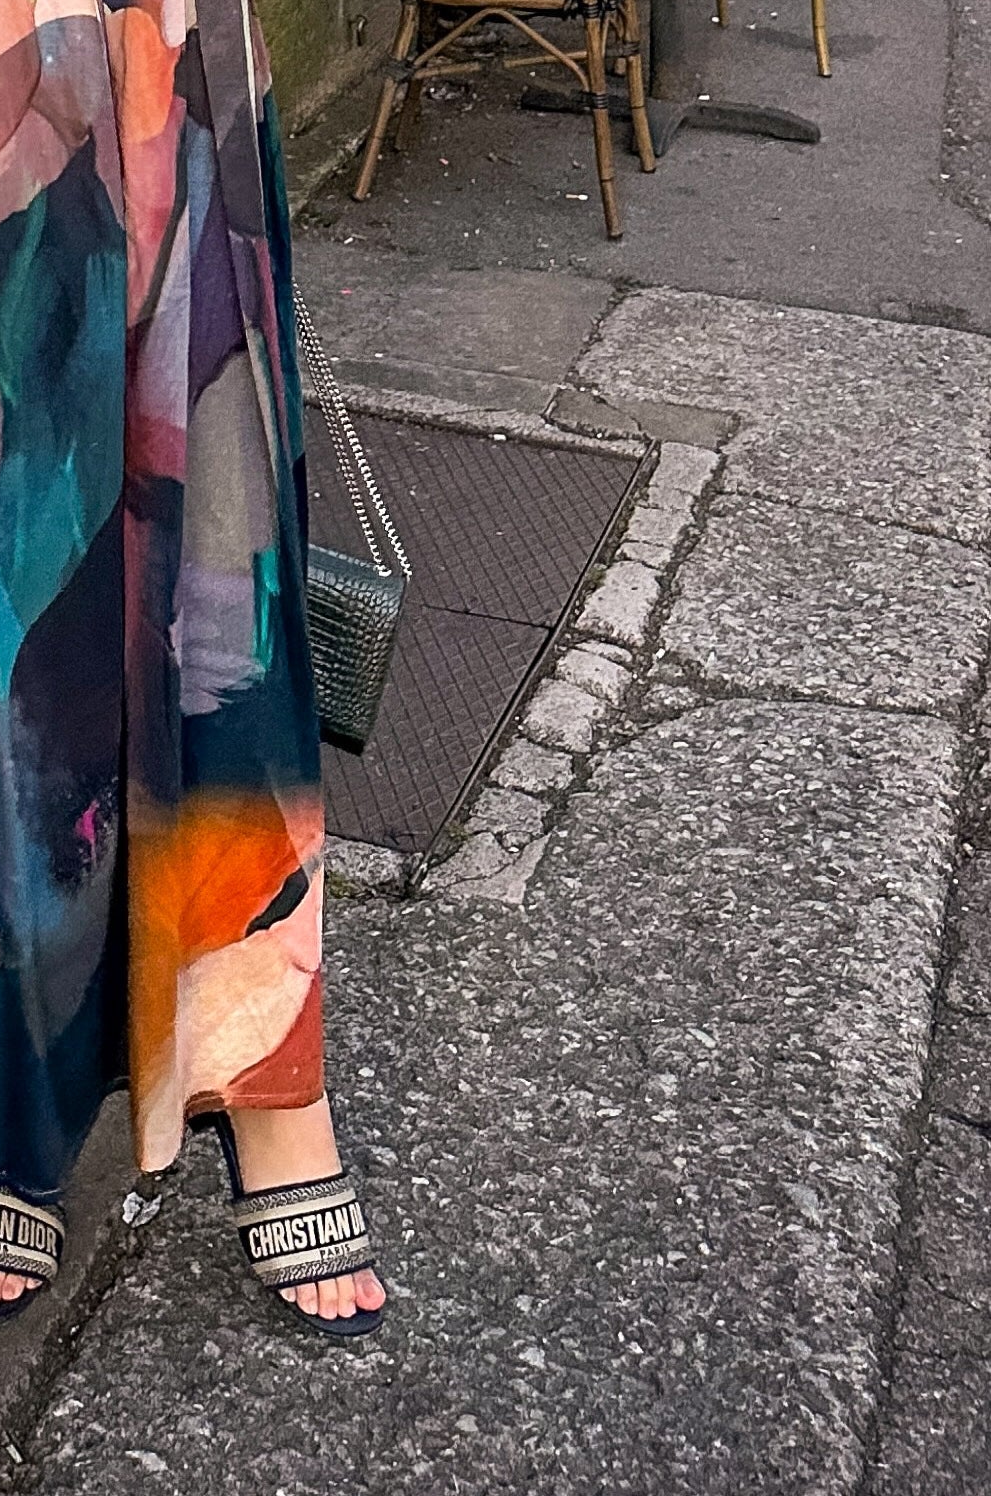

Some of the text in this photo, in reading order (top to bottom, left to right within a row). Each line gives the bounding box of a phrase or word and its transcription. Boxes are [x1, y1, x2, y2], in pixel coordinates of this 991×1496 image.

[18, 1215, 57, 1257] DIOR
[248, 1206, 351, 1259] CHRISTIAN
[319, 1244, 350, 1261] PARIS
